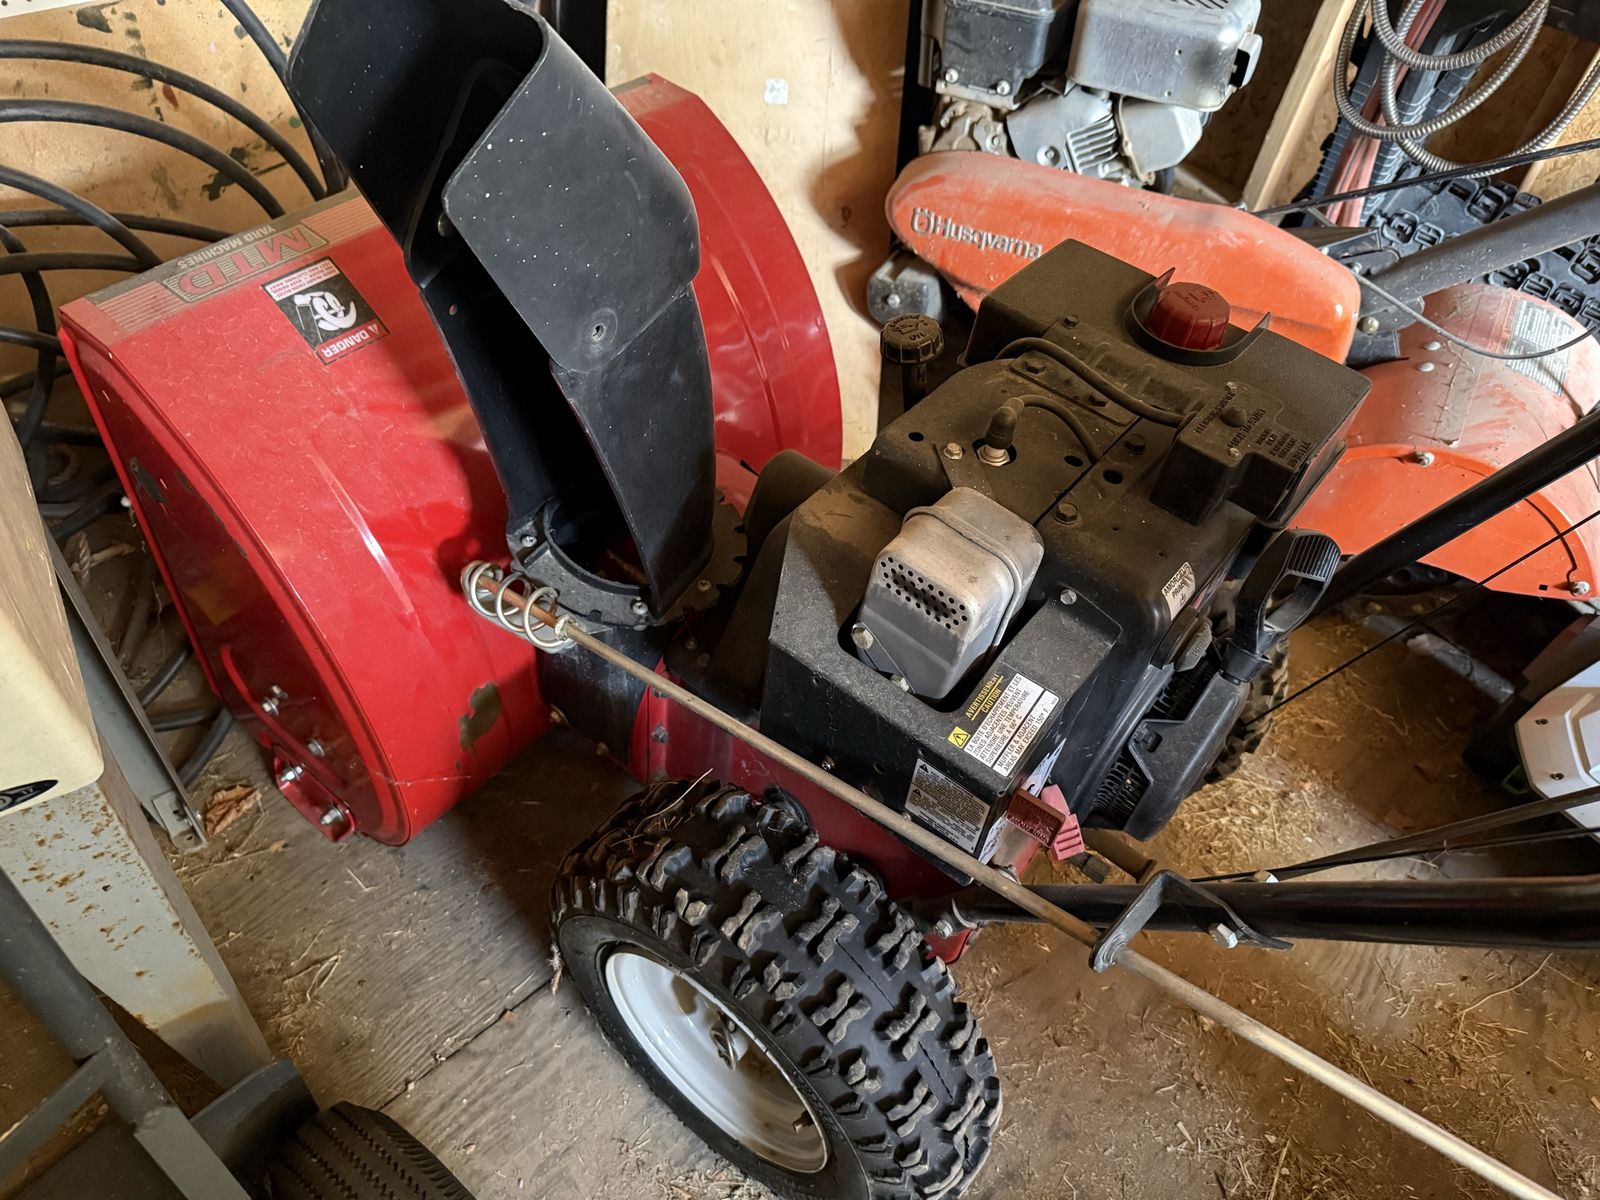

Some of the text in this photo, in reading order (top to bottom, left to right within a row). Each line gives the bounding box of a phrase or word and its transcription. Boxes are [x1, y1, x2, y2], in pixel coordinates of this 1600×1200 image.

[176, 223, 275, 269] YARD MACHINES
[934, 215, 1043, 259] Husqvarna
[178, 227, 310, 295] MTD
[321, 328, 369, 358] DANGER
[909, 332, 925, 340] OIL
[964, 672, 1000, 718] AVERTISSEMENT
[966, 674, 1021, 752] LA BOITE D'ECHAPPEMENT ET LES
[981, 687, 1001, 713] CAUTION
[972, 687, 1022, 756] ZONES ADJACENTES PEUVENT
[978, 689, 1030, 760] ATTEINDRE UNE TEMPERATURE
[997, 714, 1035, 767] MUFFLER & ADJACENT
[984, 732, 1008, 764] SUPERIEURE
[1003, 753, 1017, 771] AREAS
[1014, 742, 1025, 755] MAY
[1022, 724, 1038, 744] EXCEED
